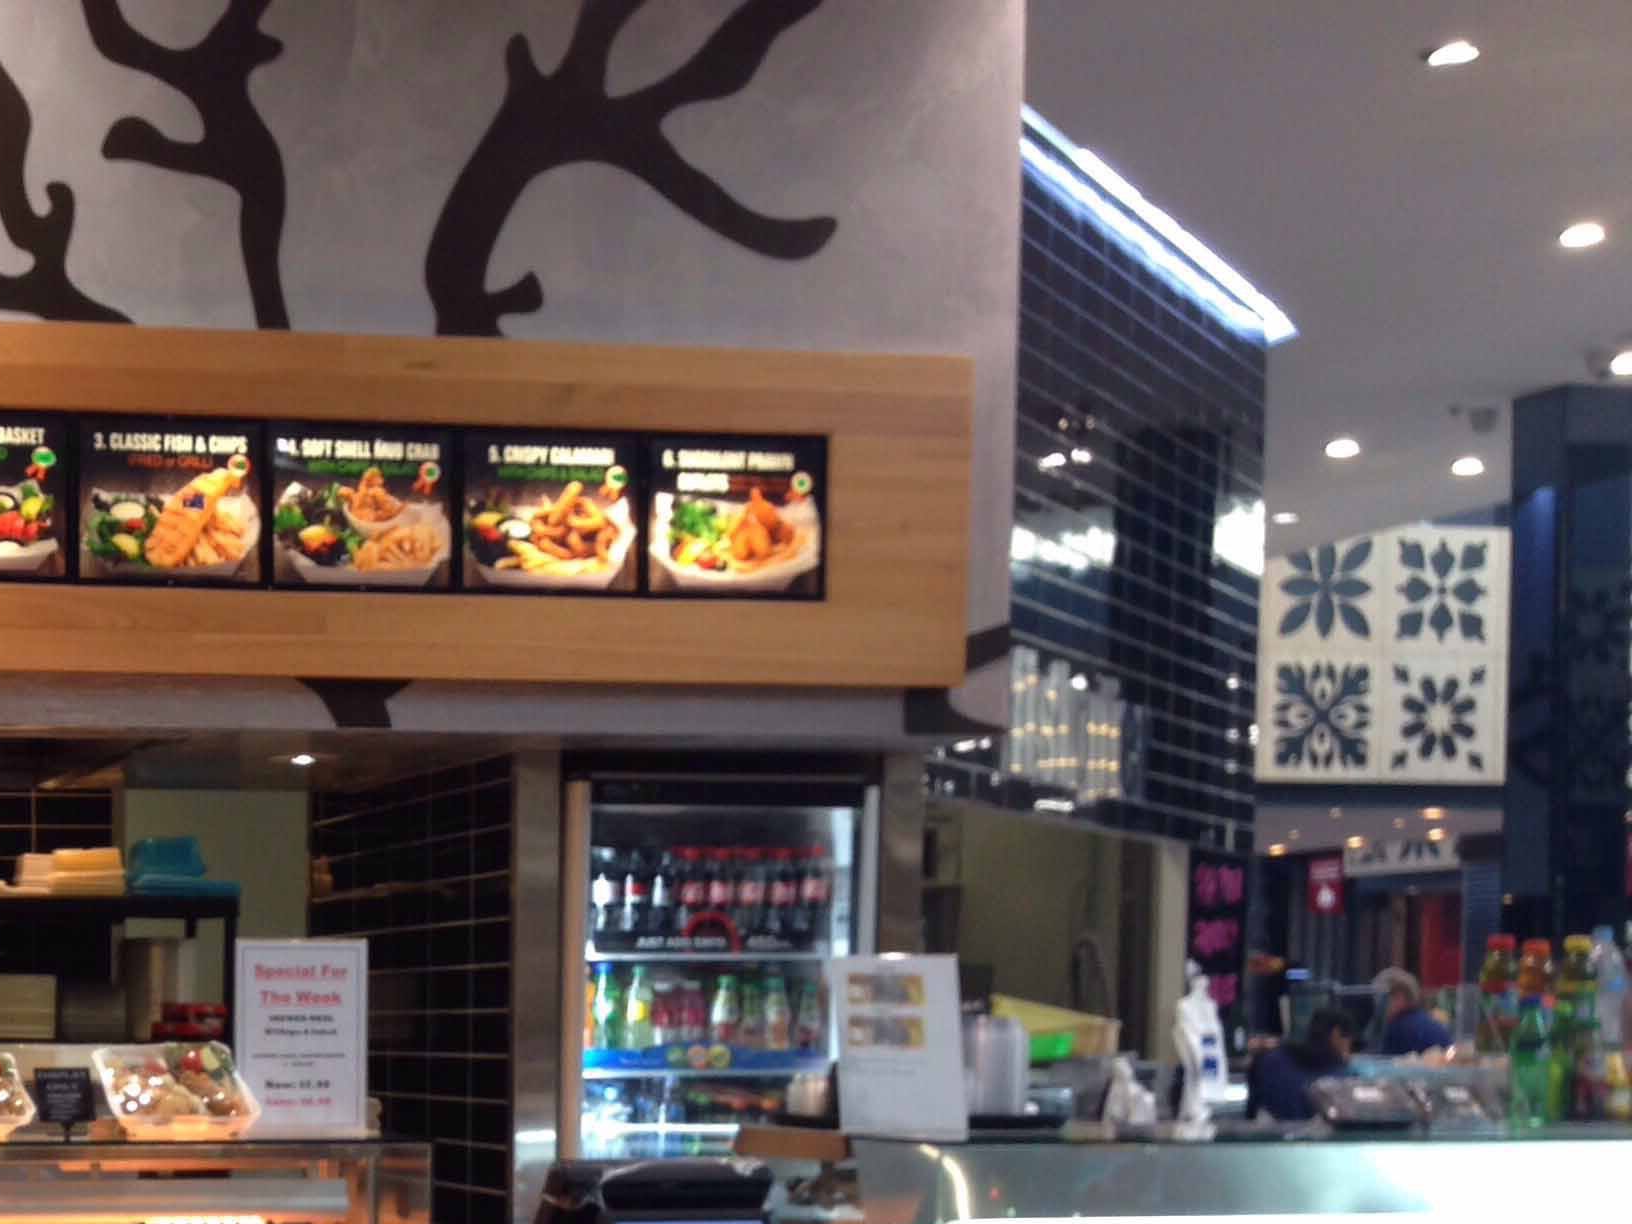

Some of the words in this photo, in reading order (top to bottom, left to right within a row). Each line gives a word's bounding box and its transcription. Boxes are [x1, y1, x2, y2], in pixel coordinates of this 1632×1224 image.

[109, 432, 162, 451] CLASSIC
[164, 433, 193, 453] FISH
[254, 964, 317, 980] Special
[321, 963, 348, 977] For
[260, 991, 291, 1005] The
[296, 991, 342, 1005] Week
